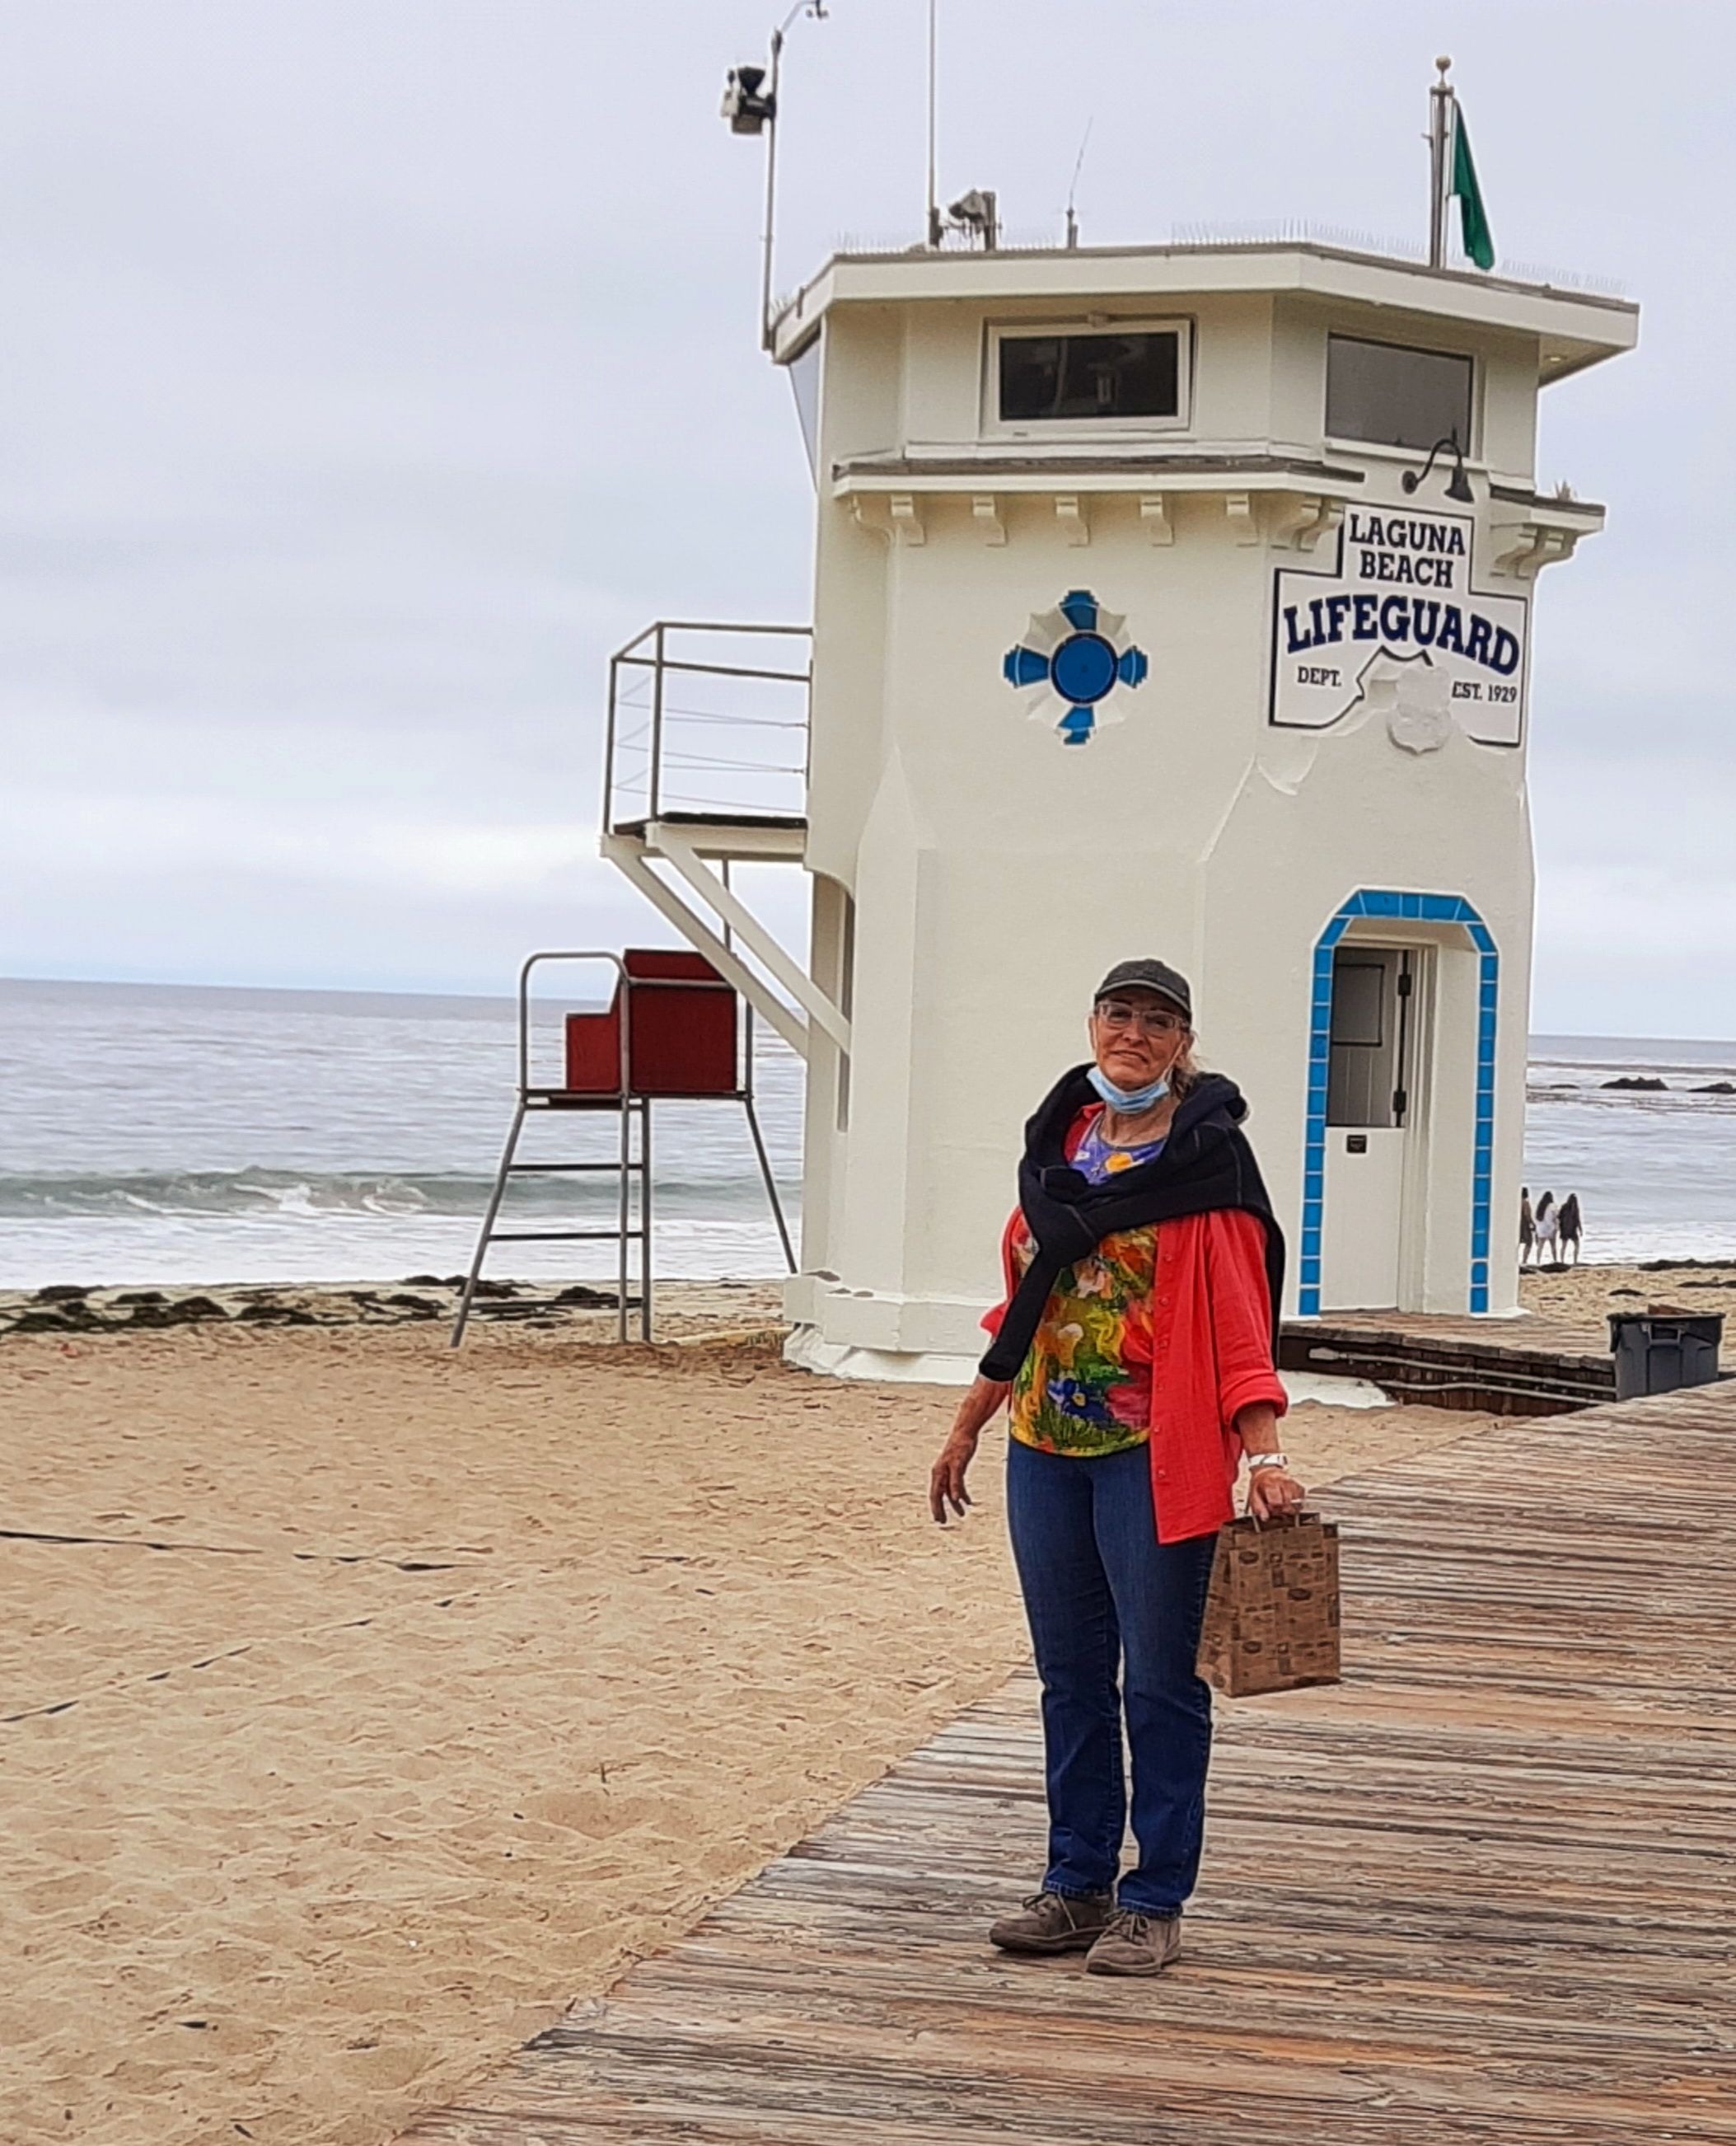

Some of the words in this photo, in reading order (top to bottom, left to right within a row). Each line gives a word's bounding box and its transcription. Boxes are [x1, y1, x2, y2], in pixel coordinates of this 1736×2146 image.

[1350, 513, 1465, 555] LAGUNA
[1359, 550, 1453, 588] BEACH
[1284, 594, 1519, 676] LIFEGUARD
[1298, 667, 1341, 686] DEPT.
[1452, 681, 1482, 700] EST.
[1488, 684, 1517, 703] 1929
